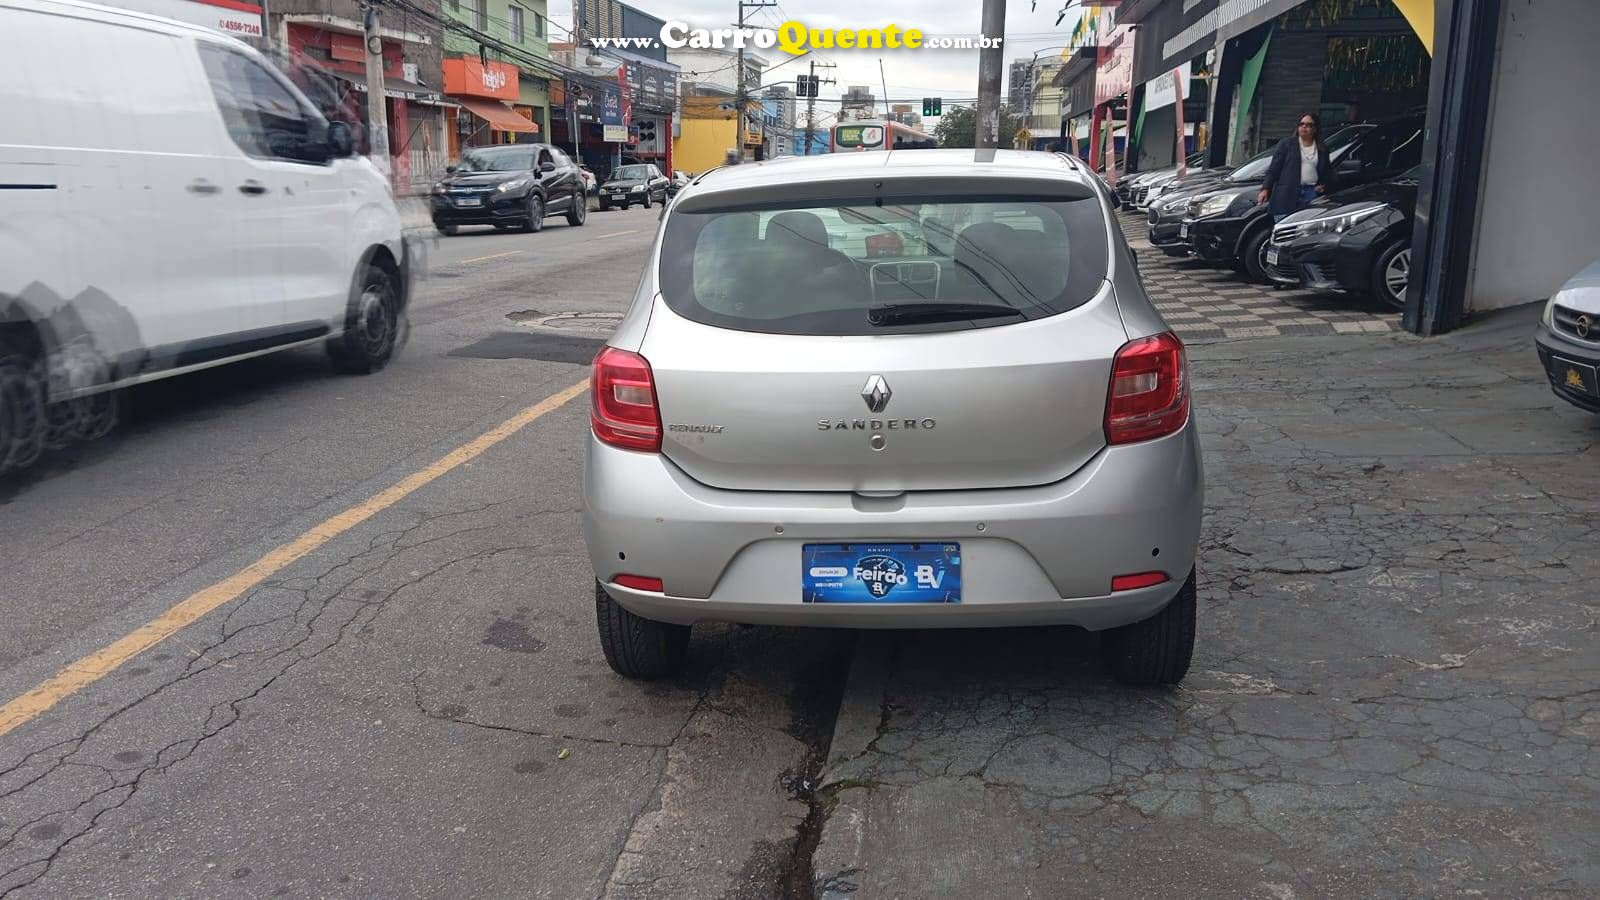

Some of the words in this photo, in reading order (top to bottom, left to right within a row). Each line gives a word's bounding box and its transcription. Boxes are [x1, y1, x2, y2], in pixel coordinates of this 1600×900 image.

[668, 423, 726, 434] RENAULT
[817, 417, 937, 431] SANDERO
[852, 566, 909, 585] Feirão
